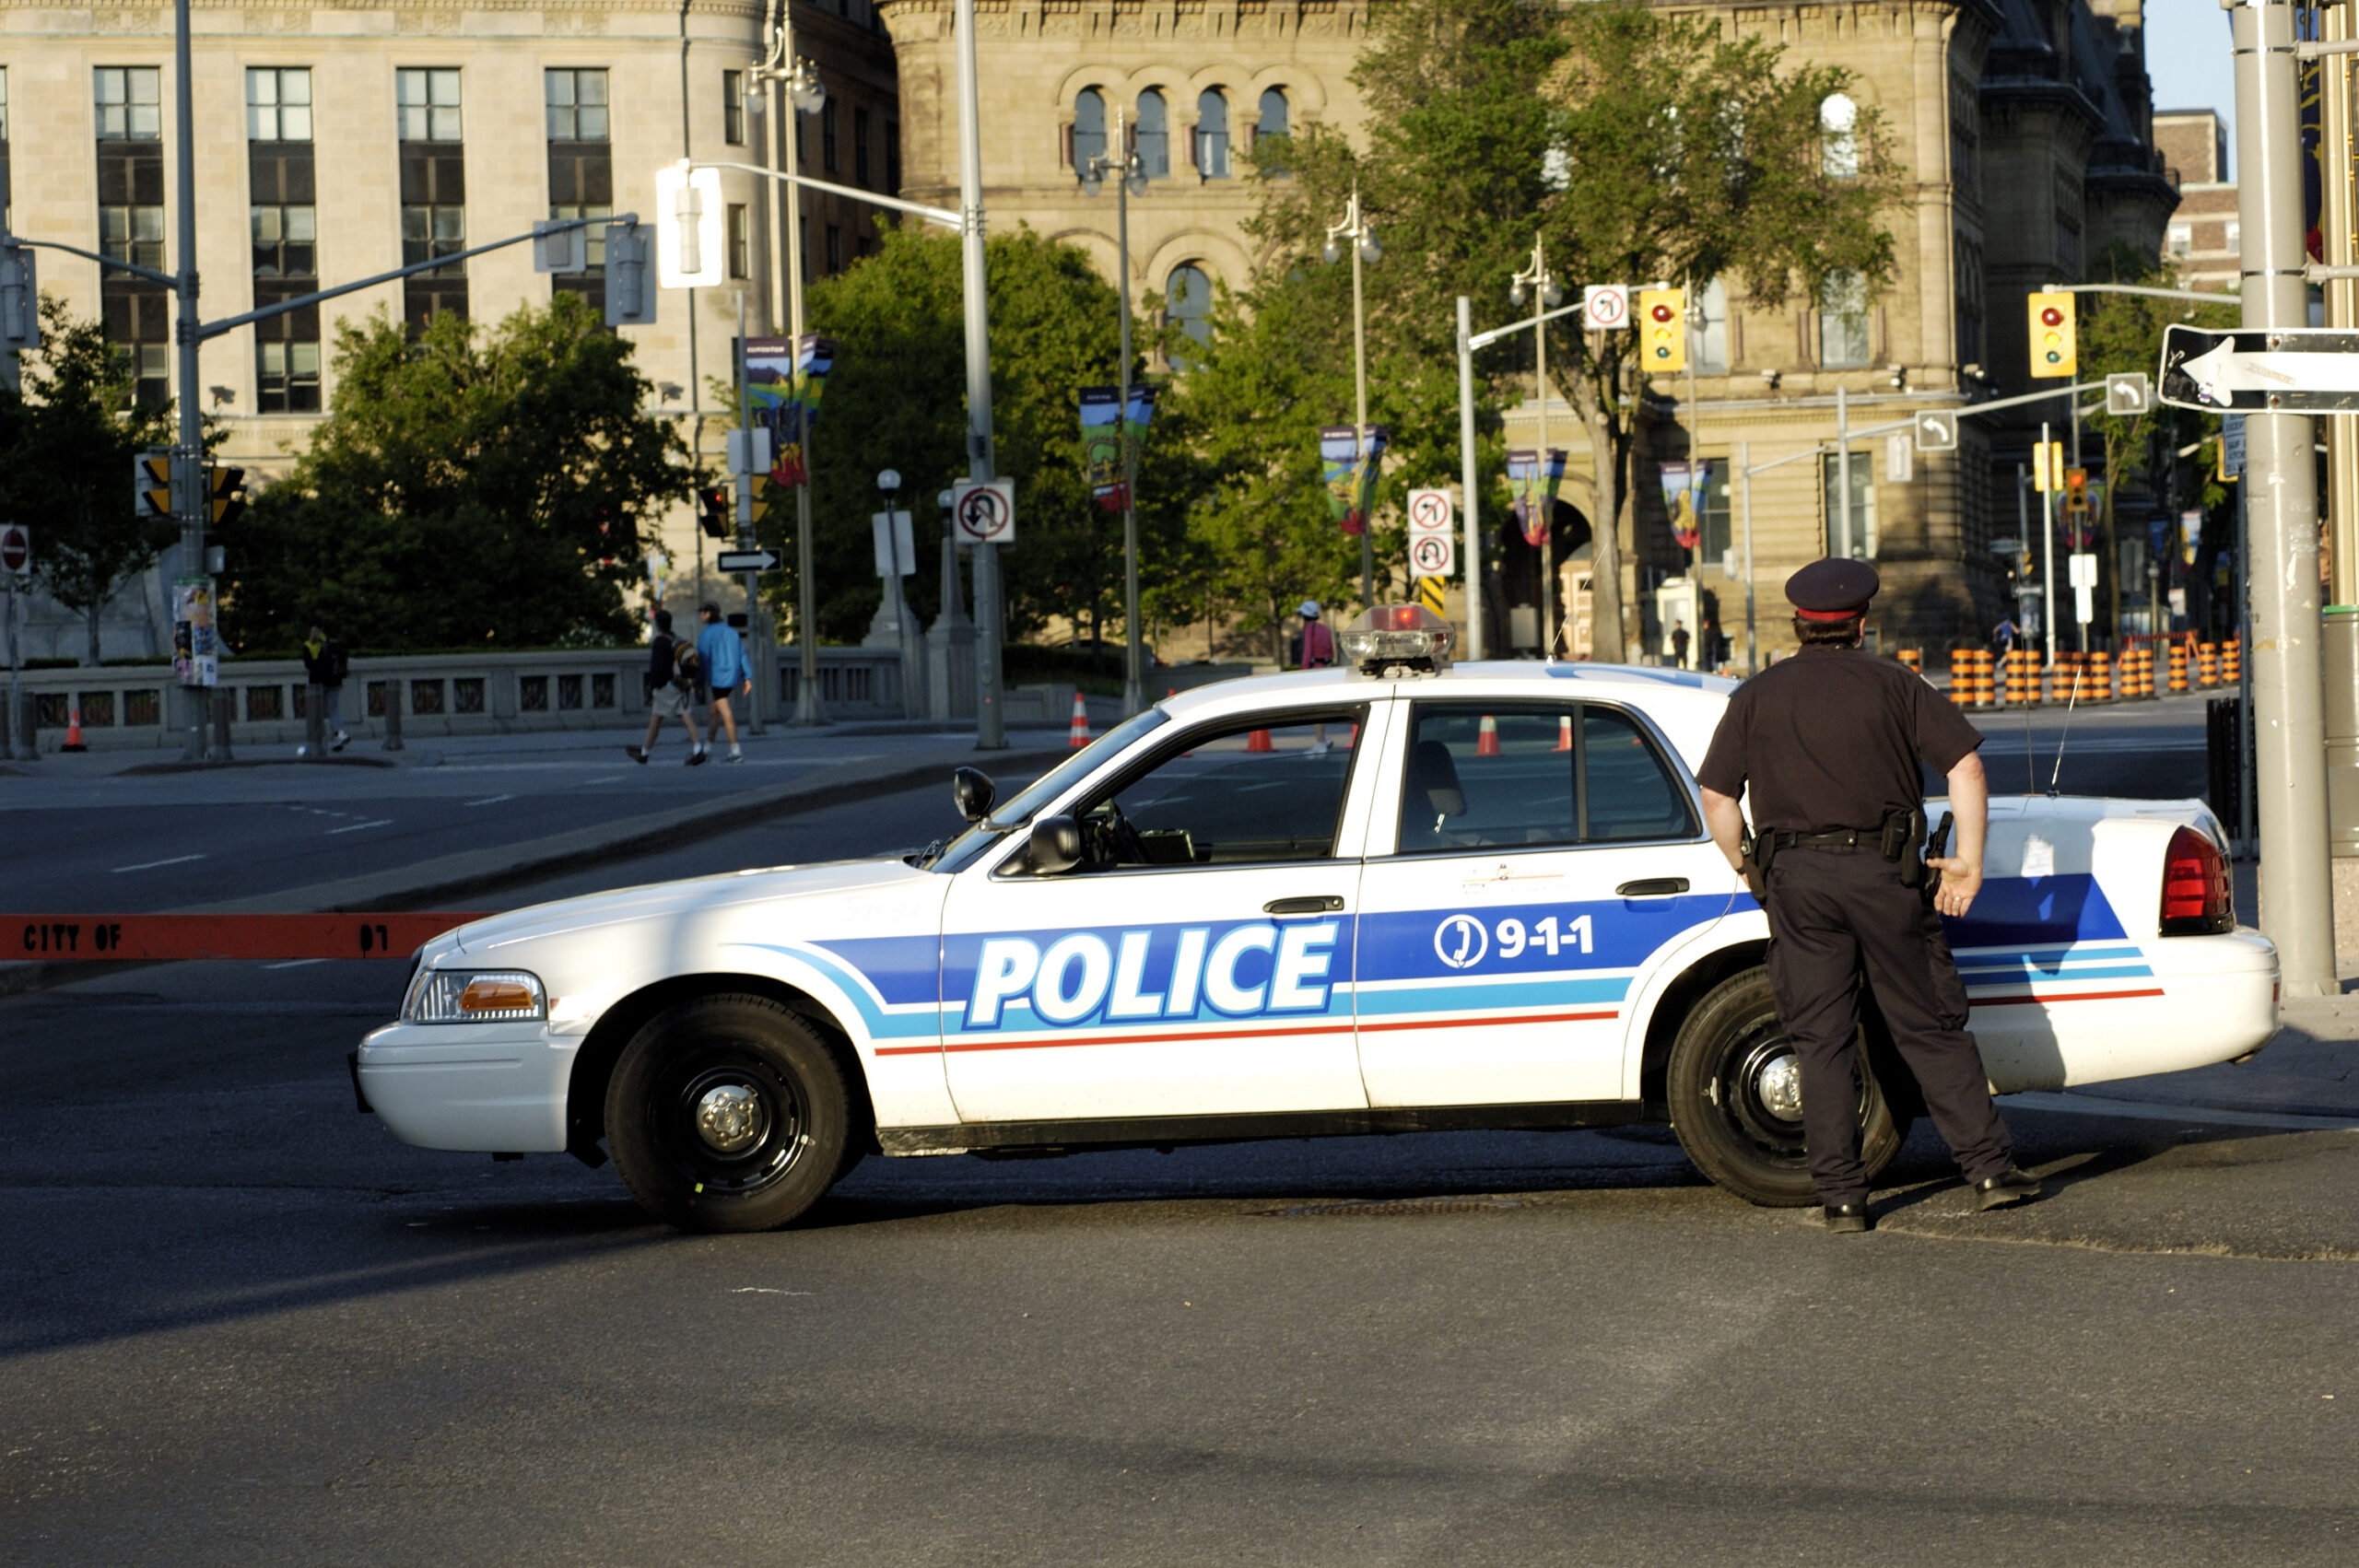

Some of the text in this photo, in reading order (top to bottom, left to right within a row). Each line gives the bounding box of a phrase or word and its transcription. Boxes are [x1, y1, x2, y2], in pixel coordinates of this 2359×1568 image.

[24, 924, 122, 951] CITY OF
[1496, 914, 1593, 958] 9-1-1
[965, 921, 1340, 1028] POLICE
